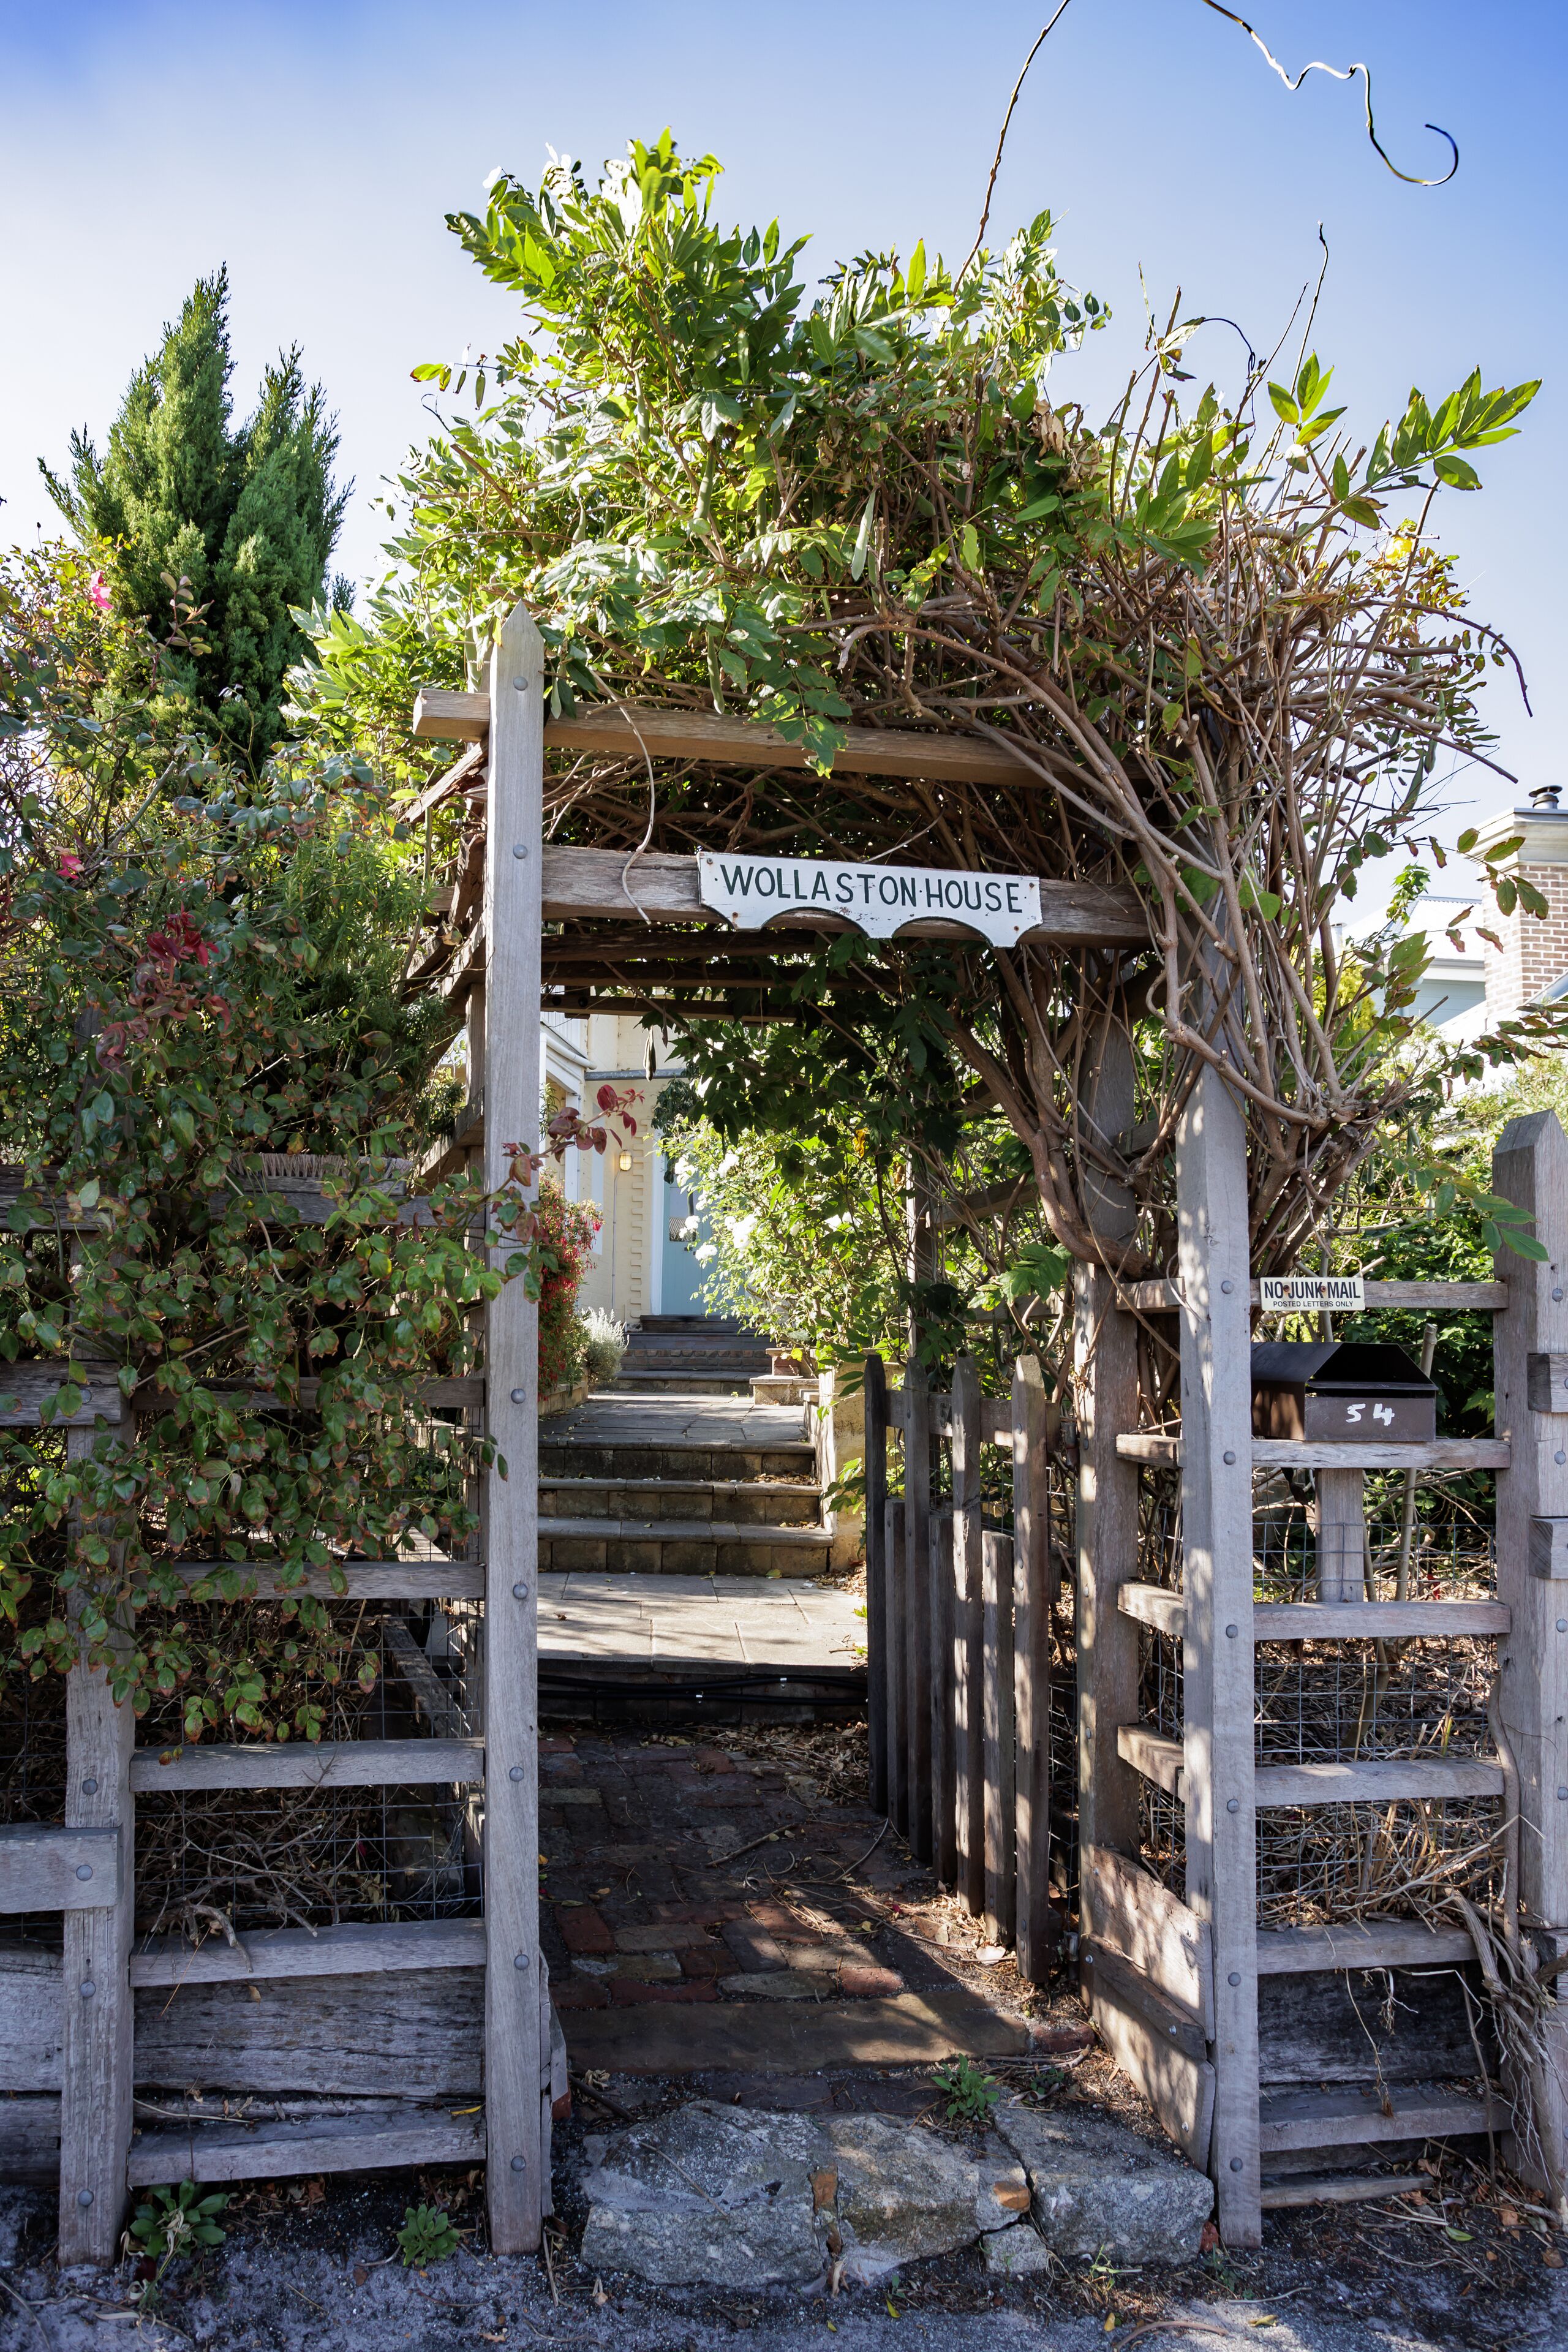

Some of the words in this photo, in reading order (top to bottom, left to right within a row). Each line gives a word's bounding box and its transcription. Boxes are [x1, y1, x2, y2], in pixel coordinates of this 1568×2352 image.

[720, 864, 917, 907] WOLLASTON
[925, 878, 1023, 913] HOUSE
[1264, 1281, 1283, 1298] NO
[1288, 1281, 1324, 1298] JUNK
[1328, 1281, 1360, 1298] MAIL
